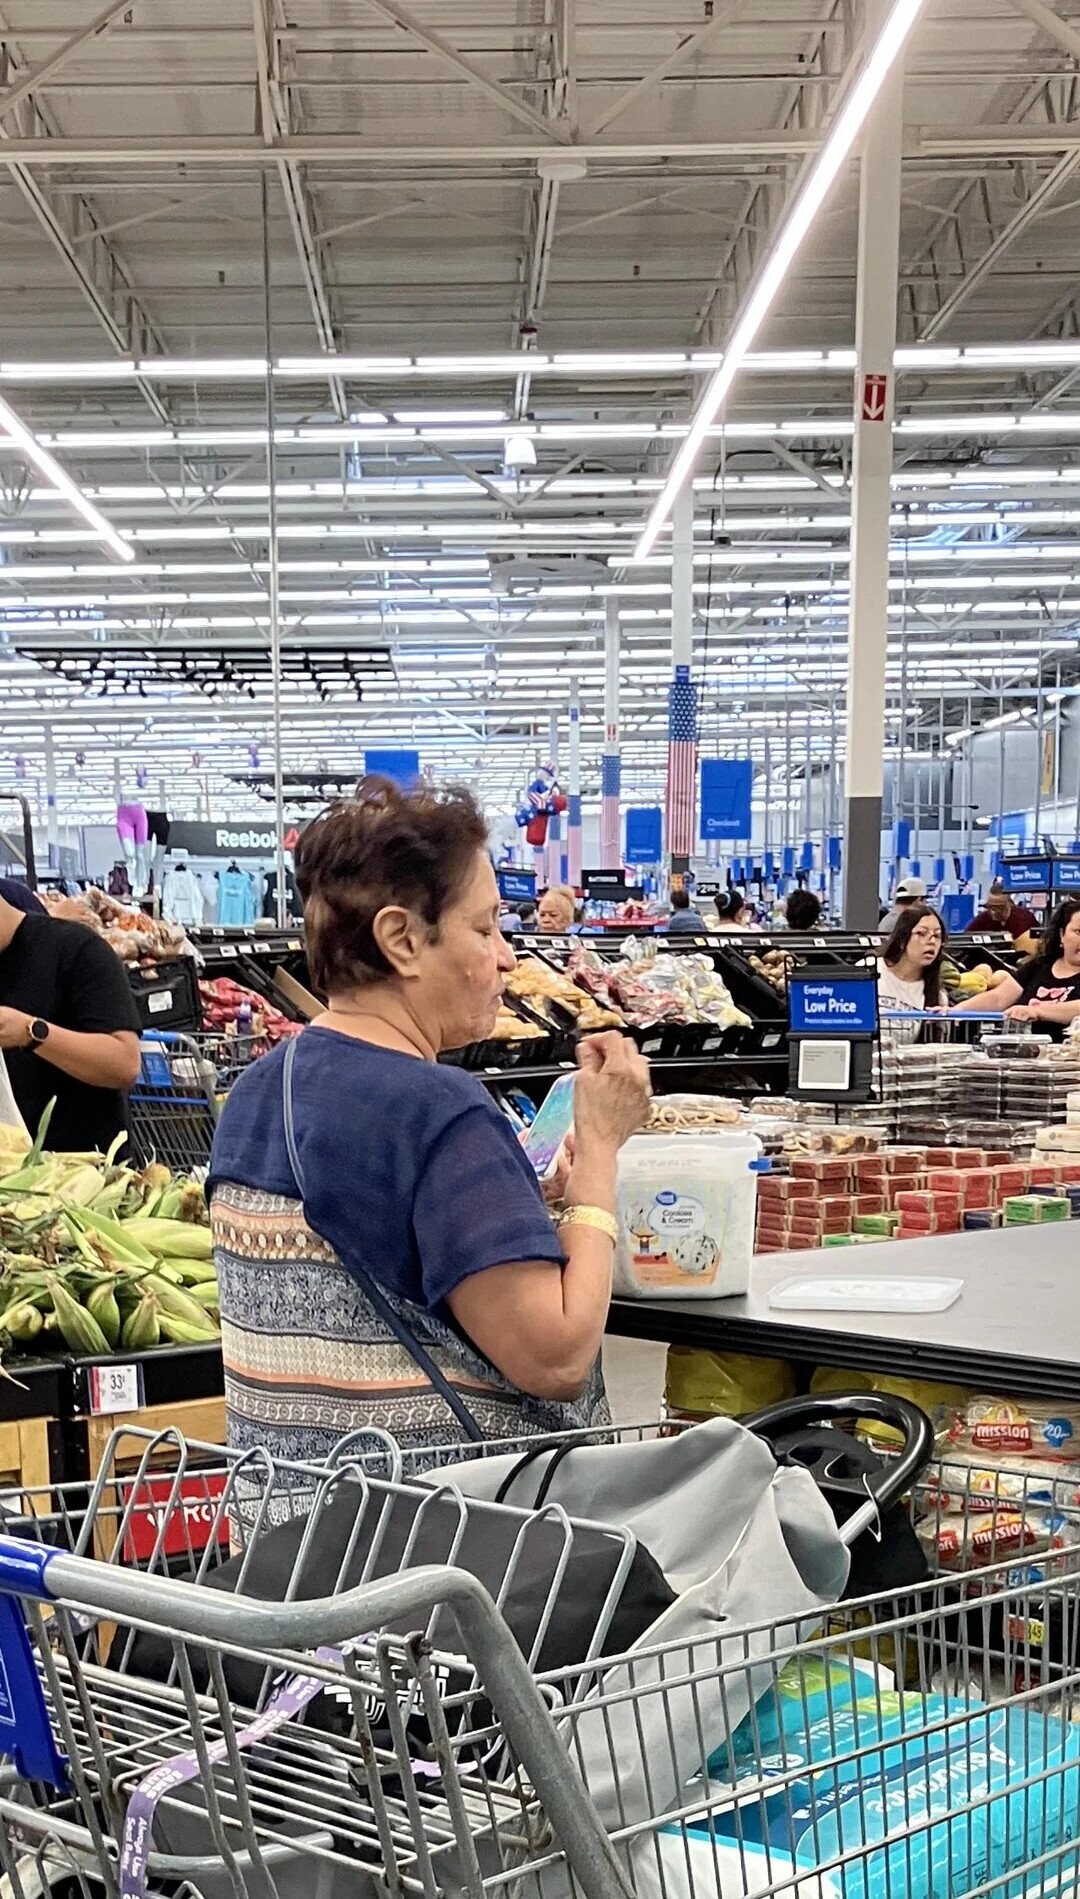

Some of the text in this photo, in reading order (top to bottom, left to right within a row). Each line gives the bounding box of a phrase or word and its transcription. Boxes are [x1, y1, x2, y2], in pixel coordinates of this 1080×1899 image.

[216, 829, 279, 848] Reebok
[804, 985, 833, 997] Everyday
[805, 997, 857, 1013] Low Price
